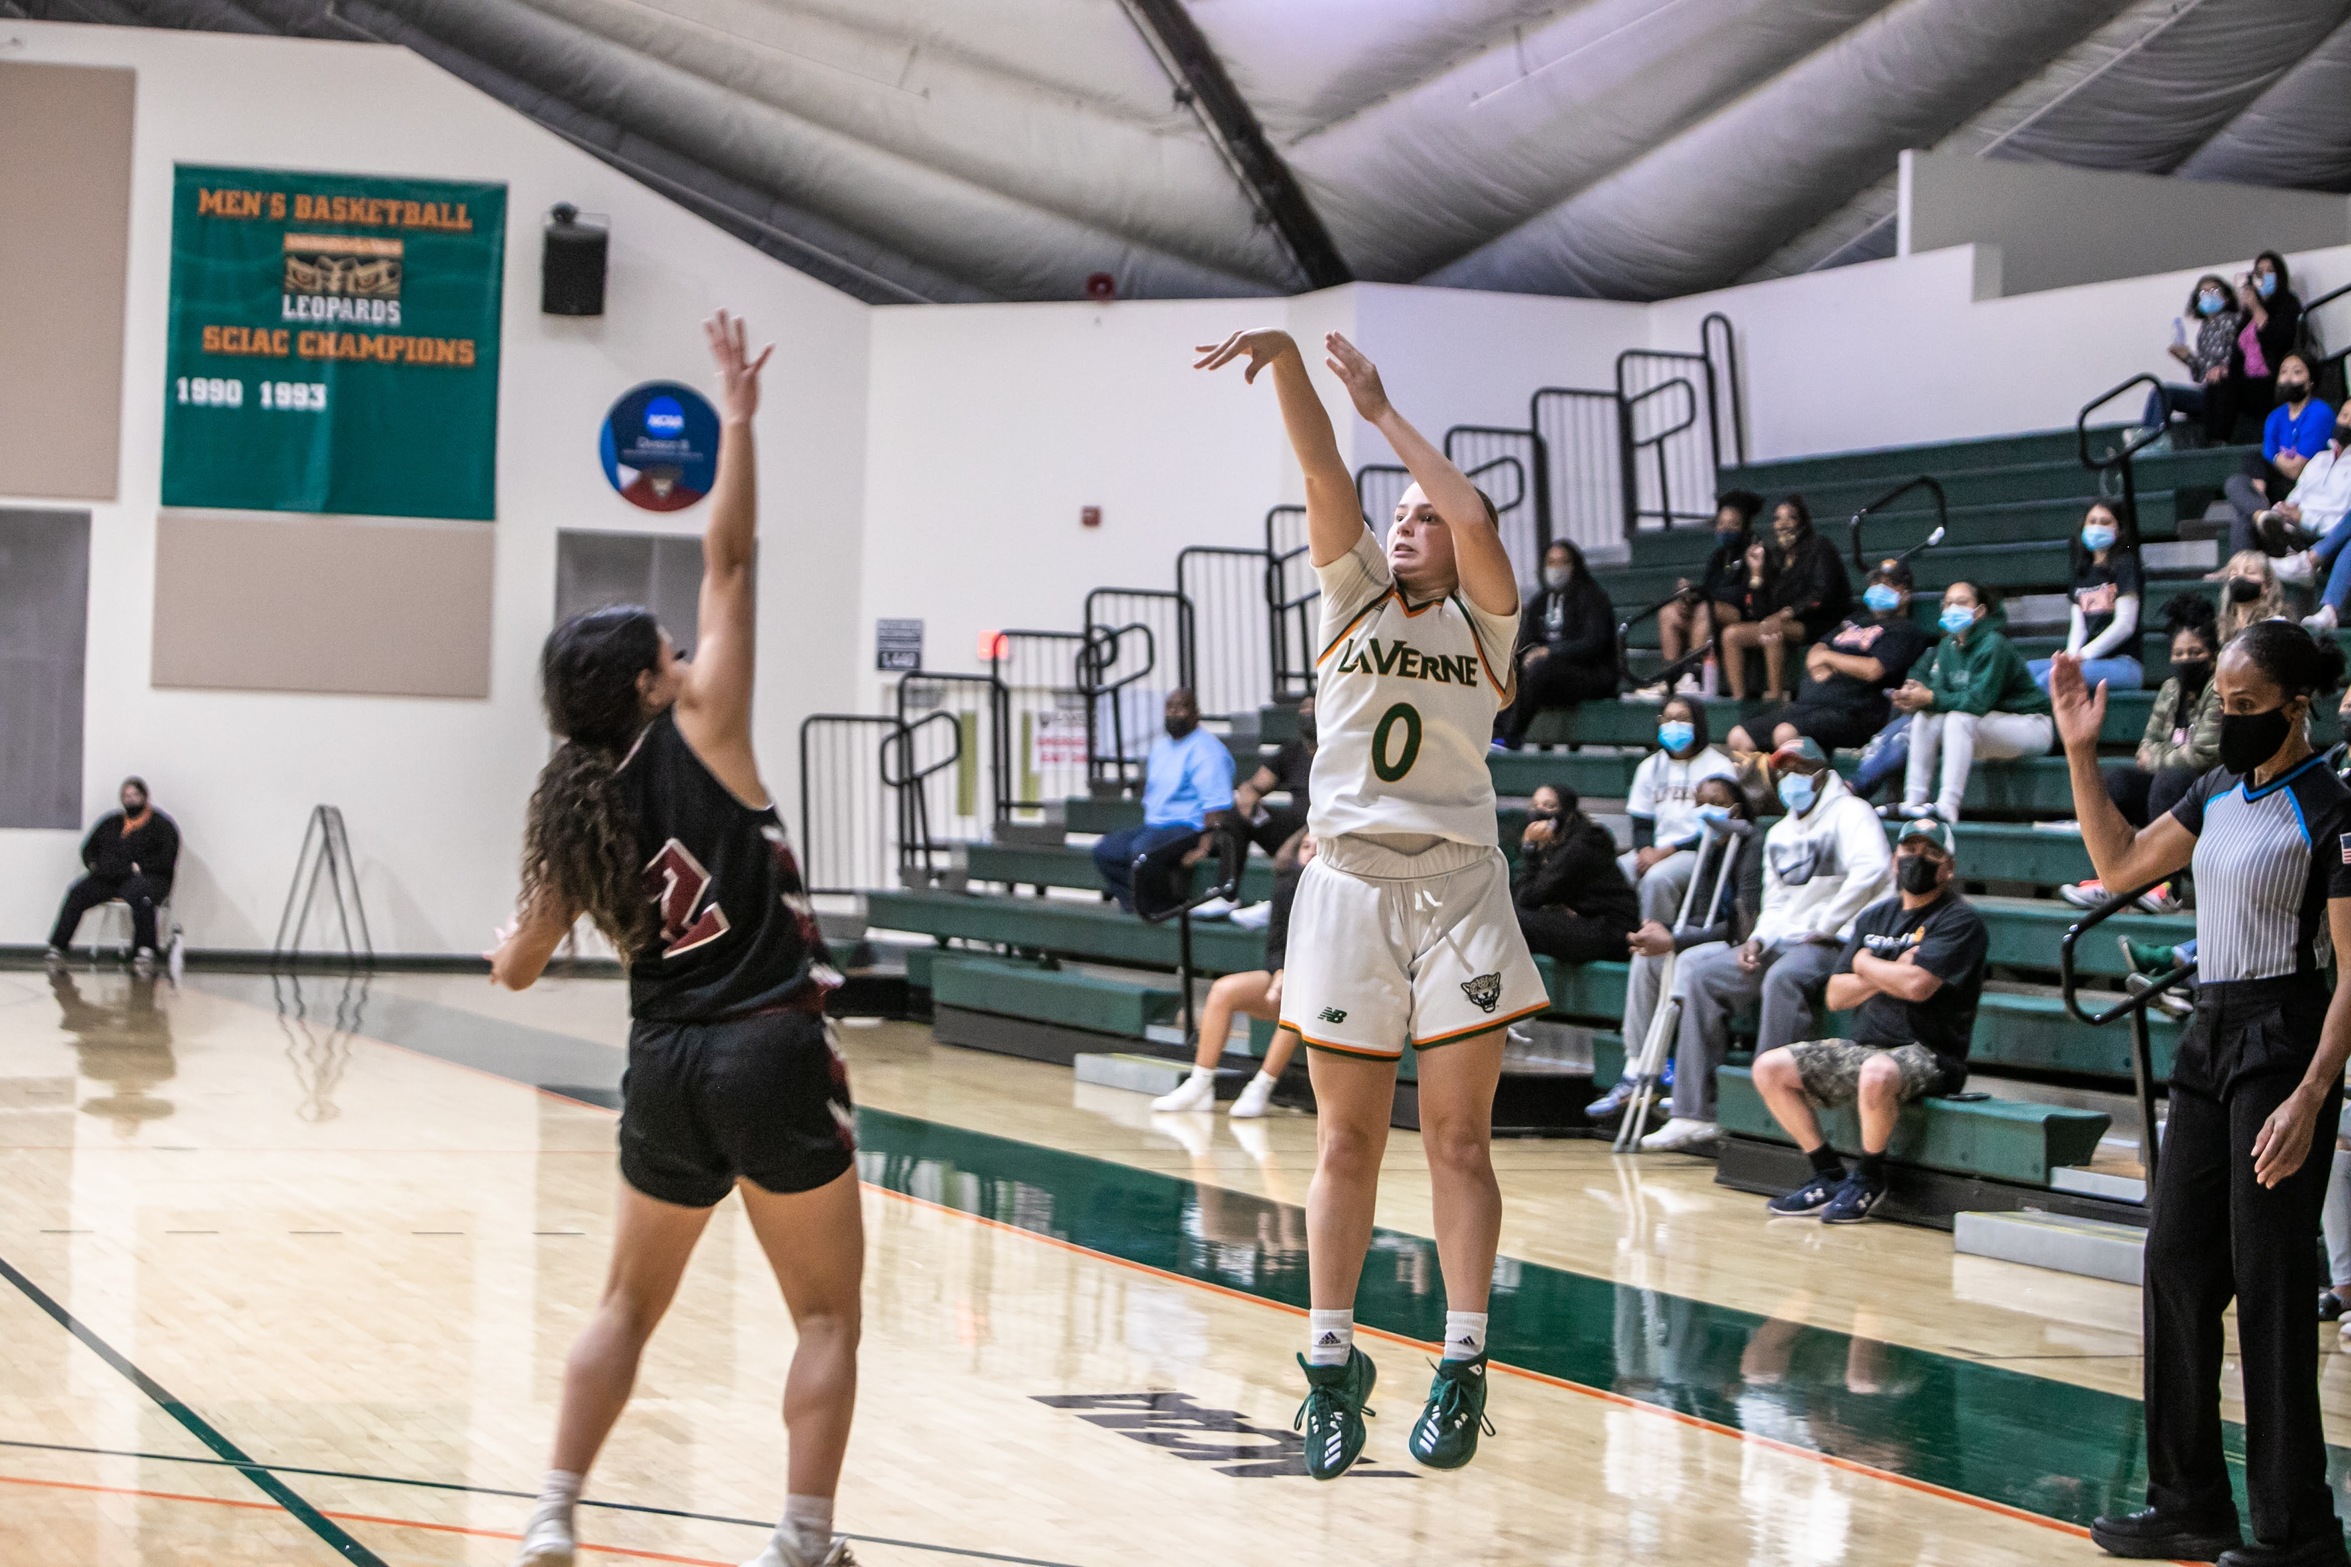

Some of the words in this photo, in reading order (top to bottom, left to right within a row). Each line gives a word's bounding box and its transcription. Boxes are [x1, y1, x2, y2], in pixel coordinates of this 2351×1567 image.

[198, 188, 286, 220] MEN'S
[294, 194, 473, 231] BASKETBALL
[282, 295, 401, 325] LEOPARDS
[203, 325, 290, 356] SCIAC
[297, 330, 475, 367] CHAMPIONS
[177, 377, 243, 407] 1990
[259, 381, 328, 412] 1993
[1371, 702, 1422, 782] 0
